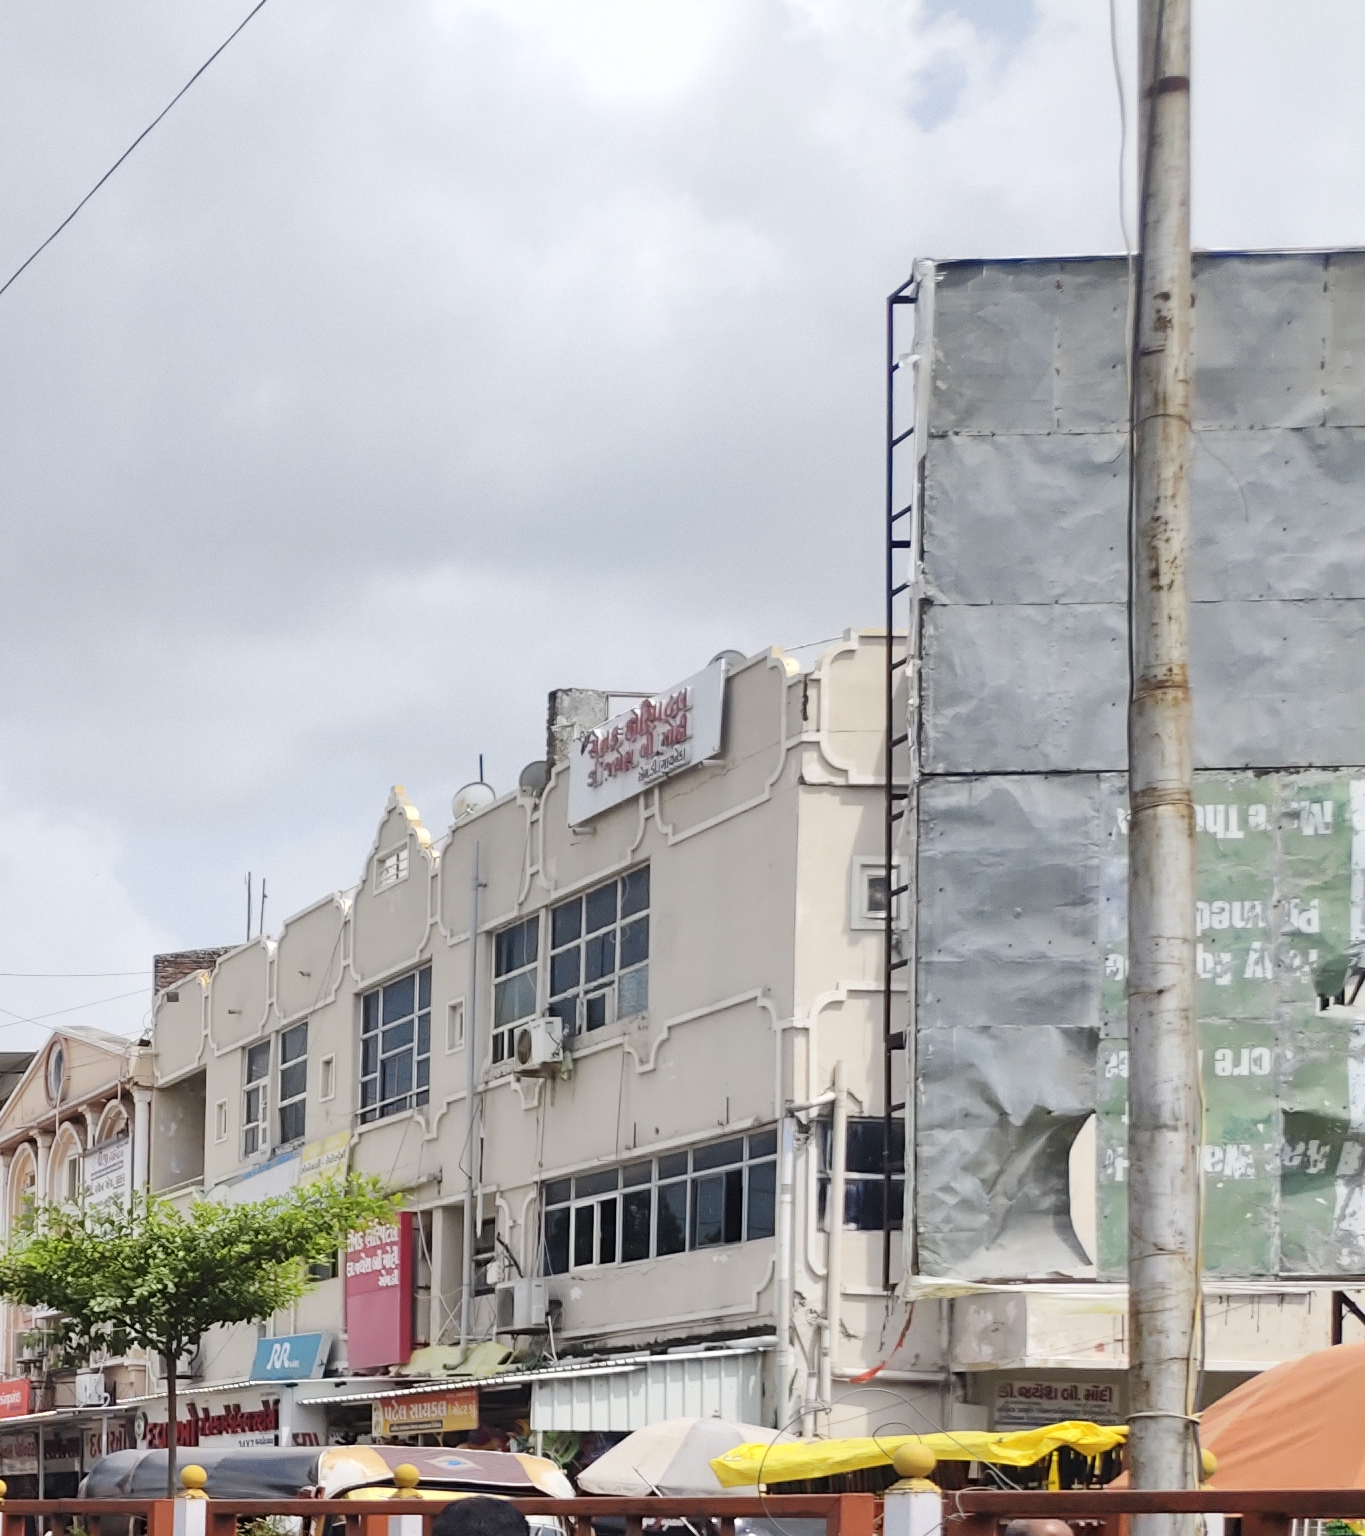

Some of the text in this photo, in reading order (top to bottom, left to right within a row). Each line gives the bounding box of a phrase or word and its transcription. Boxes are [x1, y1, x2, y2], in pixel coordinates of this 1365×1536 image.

[1085, 1384, 1113, 1402] મોદી
[384, 1399, 407, 1421] પટેલ
[409, 1400, 447, 1419] સાયકલ
